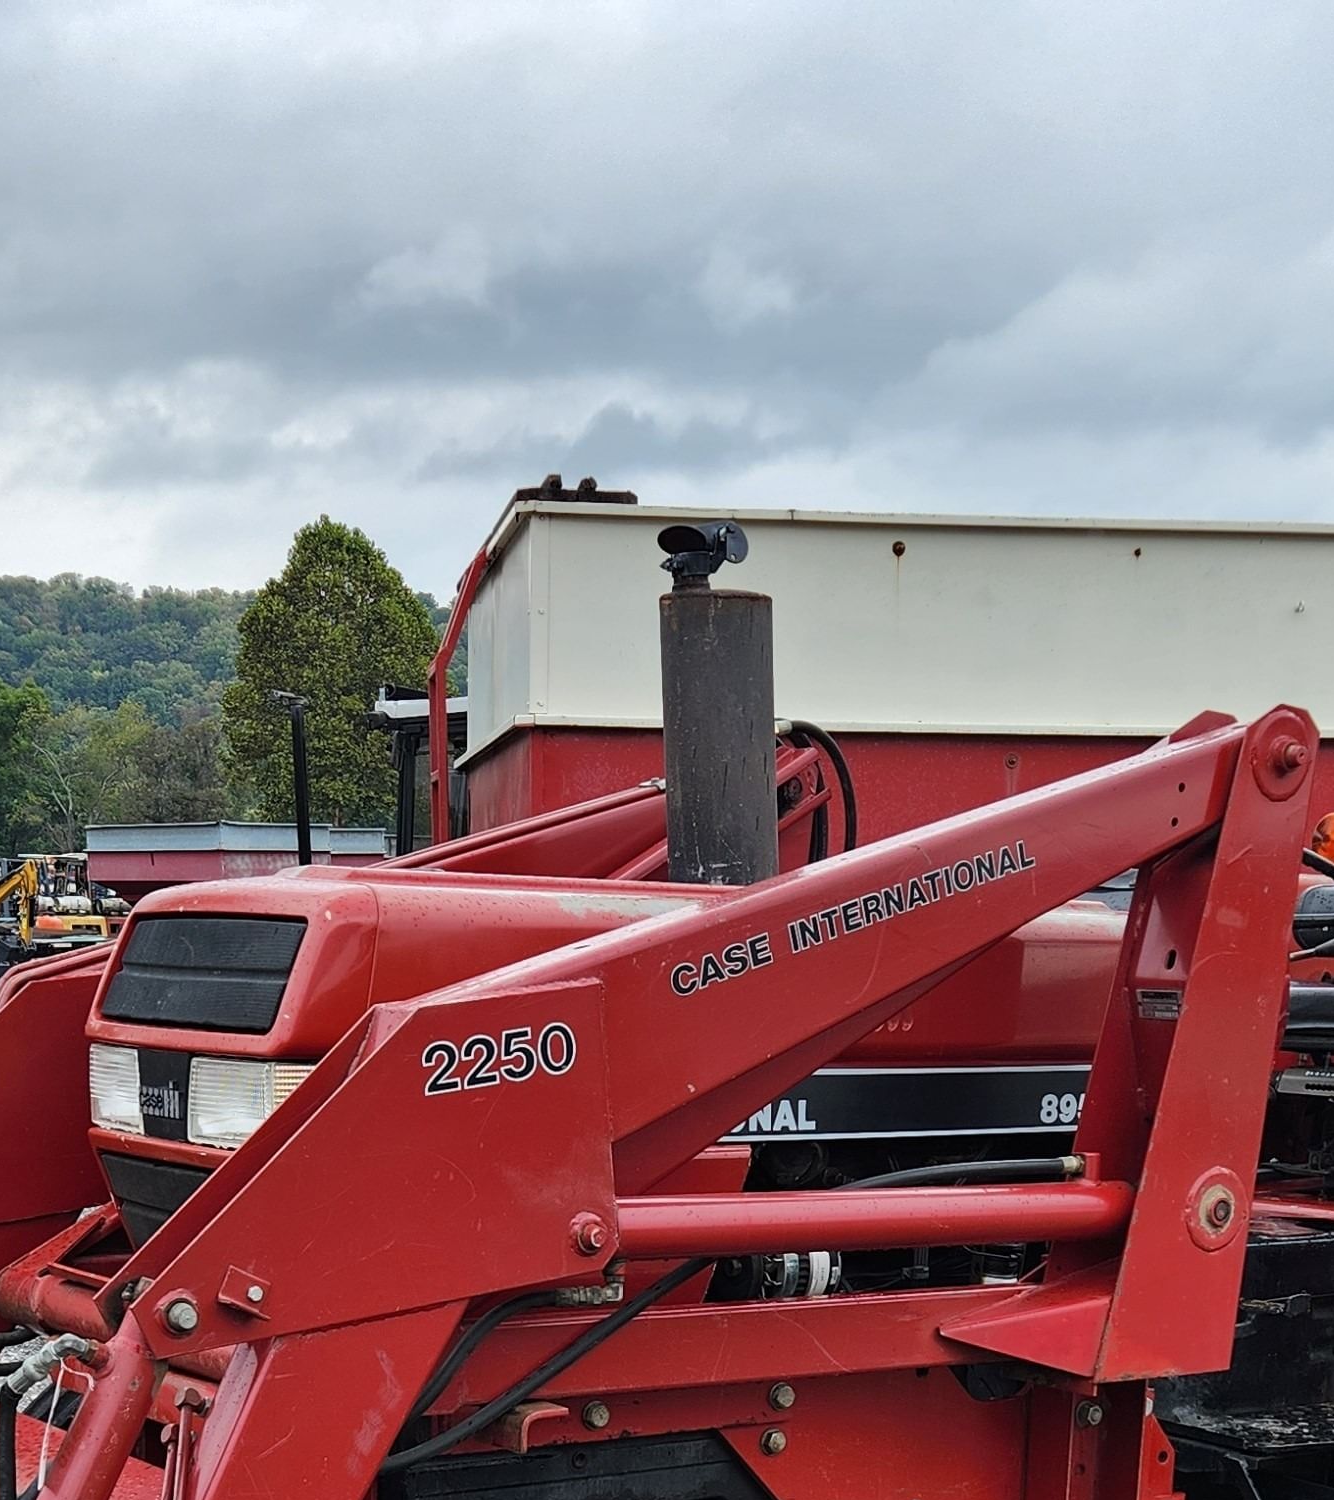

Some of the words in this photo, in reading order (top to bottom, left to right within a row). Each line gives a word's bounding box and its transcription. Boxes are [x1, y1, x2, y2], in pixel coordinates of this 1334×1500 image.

[670, 932, 773, 996] CASE
[787, 840, 1036, 954] INTERNATIONAL
[421, 1022, 576, 1097] 2250
[730, 1099, 816, 1133] NAL
